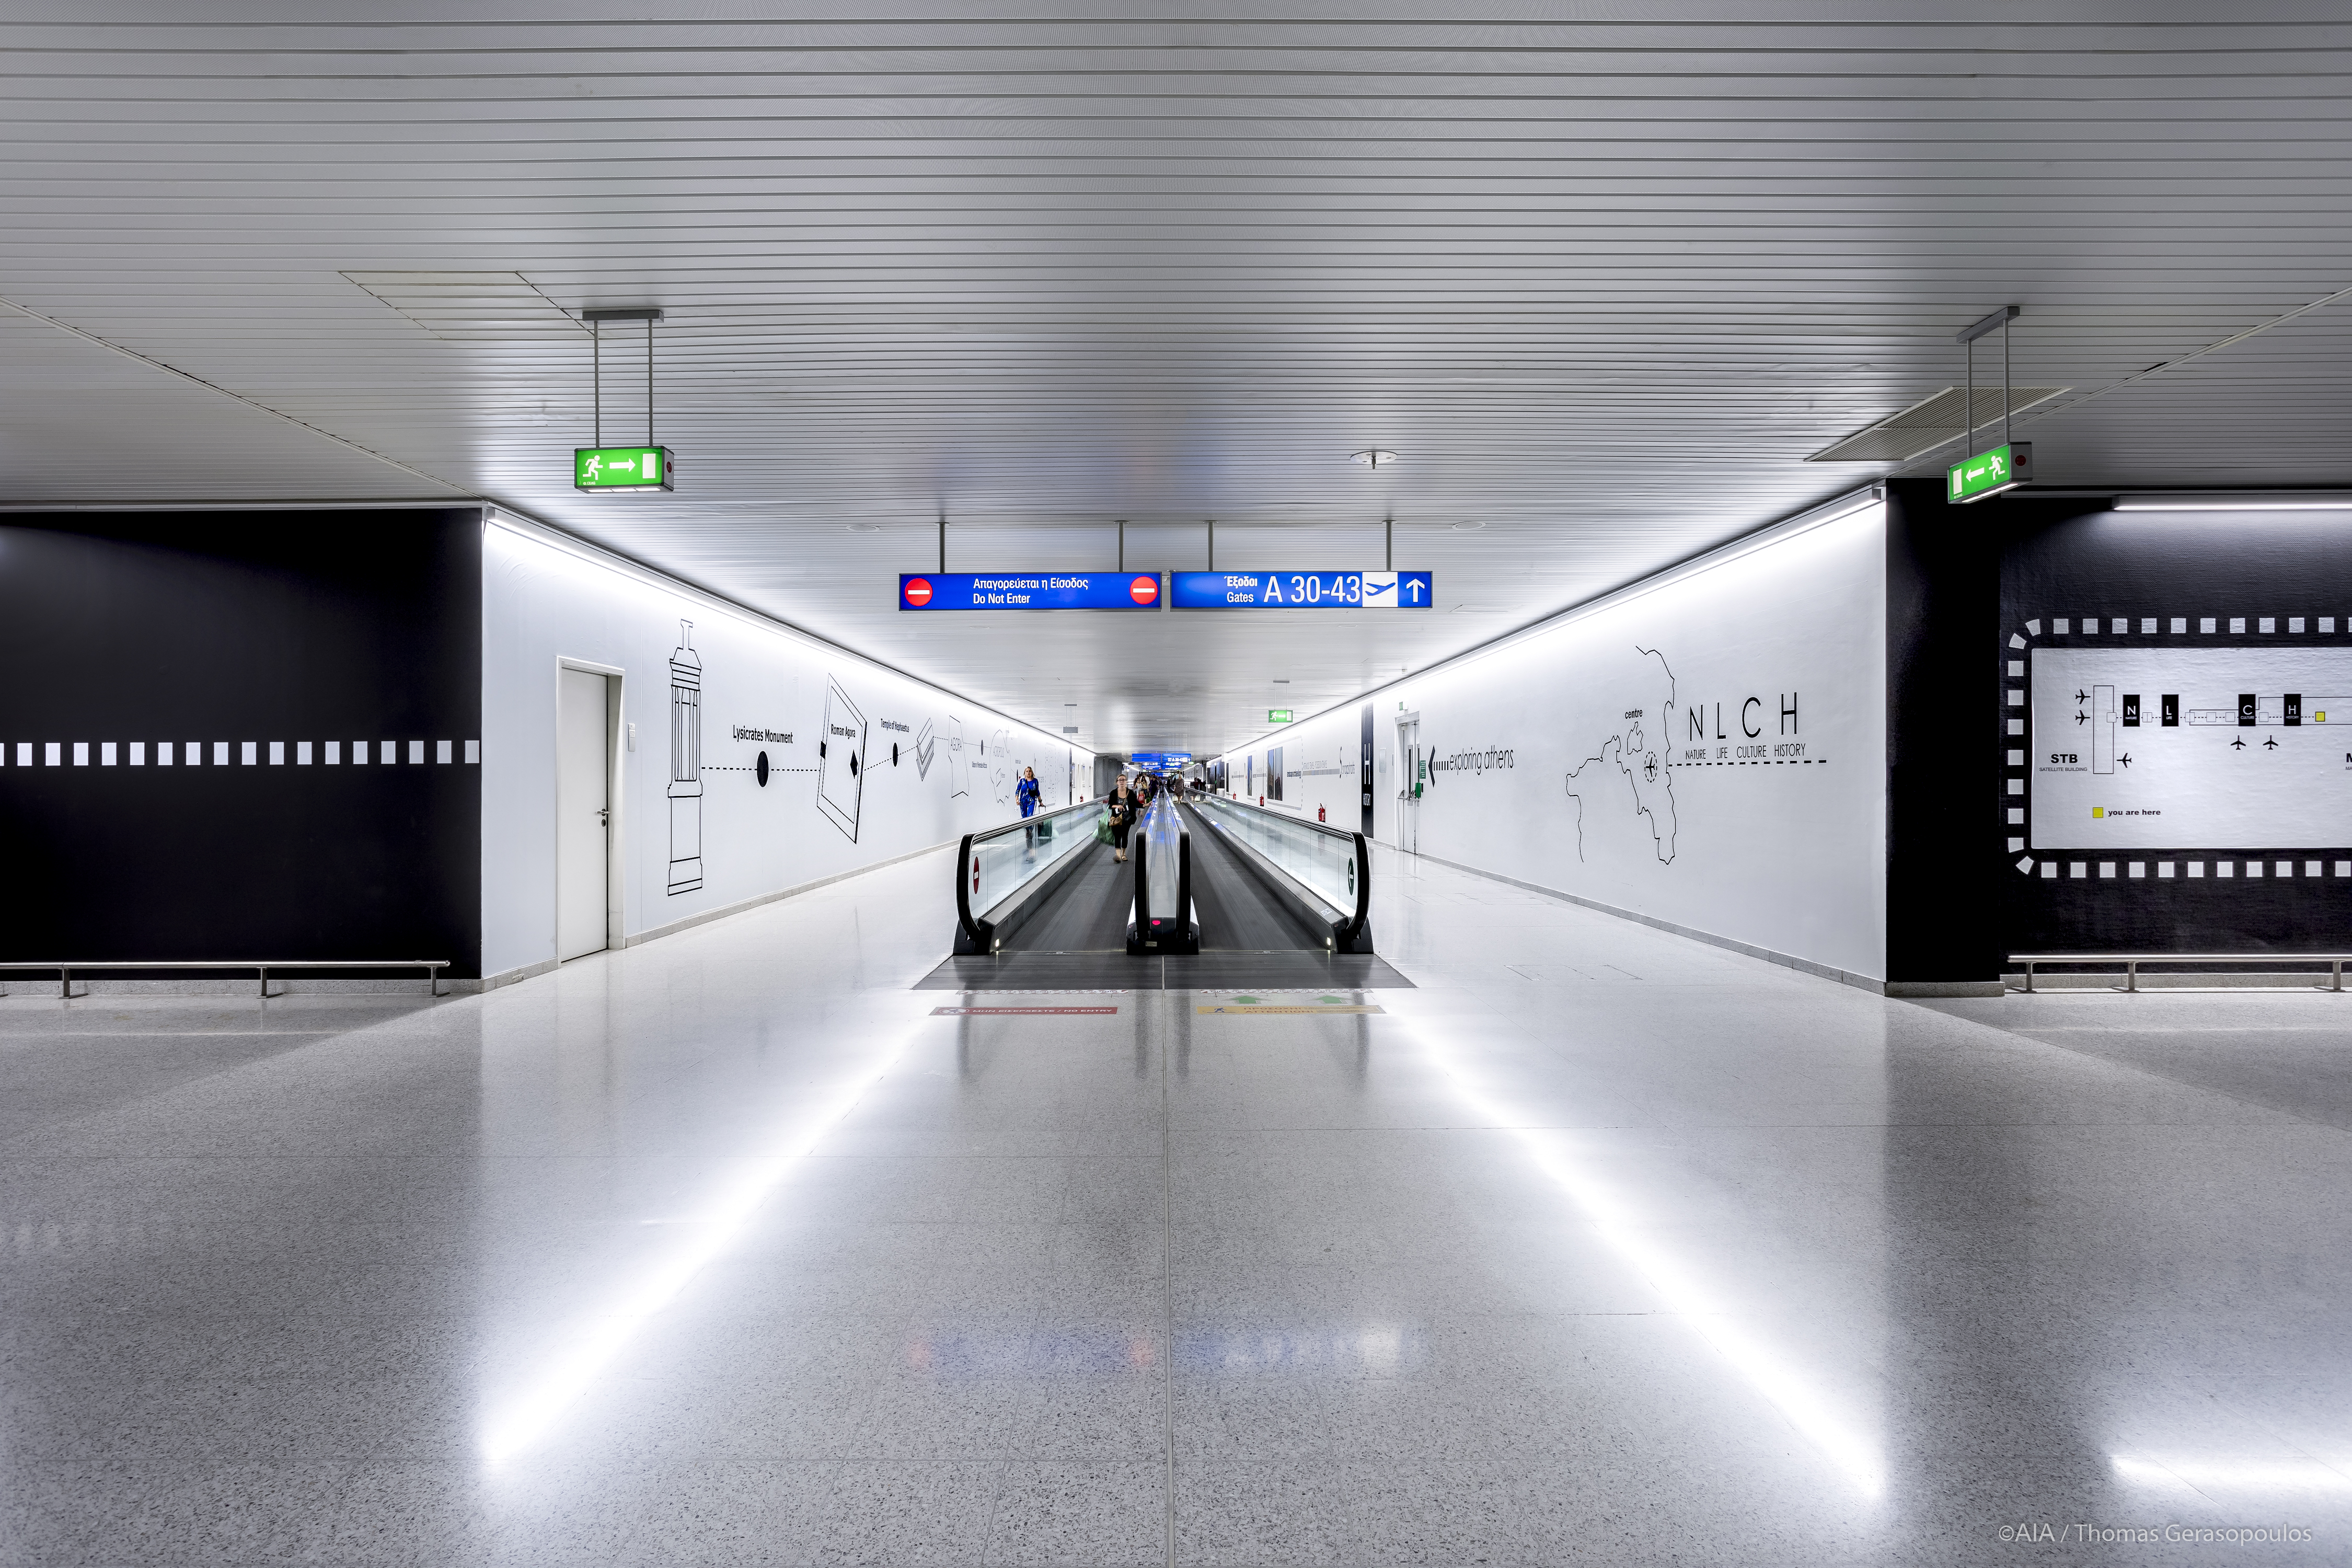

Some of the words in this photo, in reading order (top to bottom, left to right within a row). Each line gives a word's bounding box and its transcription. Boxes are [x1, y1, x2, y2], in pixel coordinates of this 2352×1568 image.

[973, 578, 1039, 591] Απαγορεύεται
[1042, 579, 1047, 590] η
[1051, 578, 1088, 590] Είσοδος
[1224, 576, 1258, 589] Έξοδοι
[1263, 575, 1283, 602] A
[1290, 575, 1360, 603] 30-43
[973, 593, 985, 604] Do
[988, 593, 1005, 604] Not
[1007, 593, 1031, 603] Enter
[1227, 592, 1254, 603] Gates
[1625, 708, 1643, 719] centre
[2127, 706, 2136, 715] N
[2166, 706, 2172, 715] L
[2243, 705, 2253, 715] C
[2288, 705, 2296, 714] H
[831, 723, 845, 736] Roman
[845, 726, 856, 739] Agora
[880, 718, 891, 731] Temple
[733, 724, 764, 742] Lysicrates
[765, 729, 793, 744] Monument
[950, 737, 962, 752] AGORA
[1686, 749, 1706, 759] NATURE
[1716, 747, 1728, 758] LIFE
[1736, 745, 1767, 758] CULTURE
[1774, 743, 1806, 757] HISTORY
[1450, 746, 1482, 775] exploring
[1484, 745, 1514, 769] athens
[2051, 754, 2078, 764] STB
